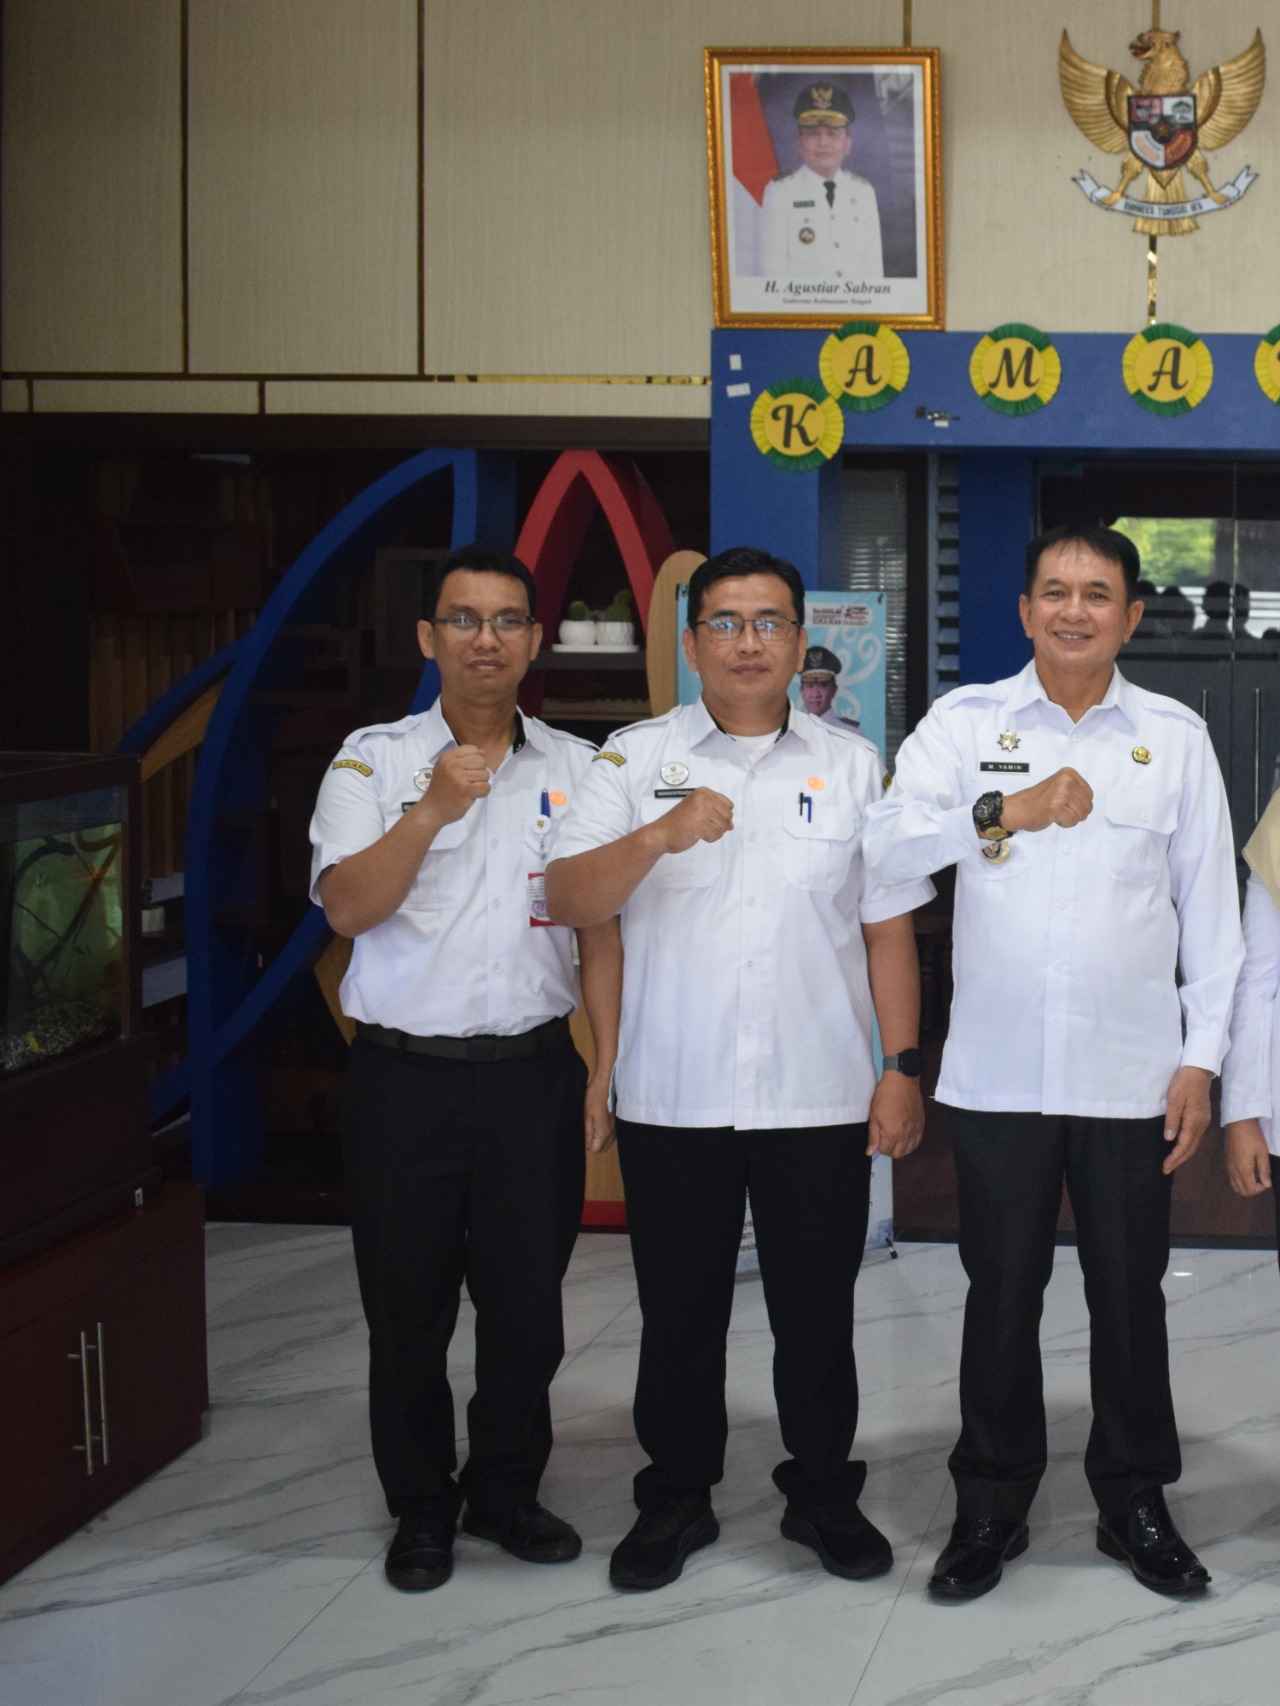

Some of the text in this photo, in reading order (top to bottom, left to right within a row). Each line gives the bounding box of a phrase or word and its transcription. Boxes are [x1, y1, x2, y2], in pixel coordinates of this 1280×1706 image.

[765, 280, 891, 297] H. Agustiar Sabran
